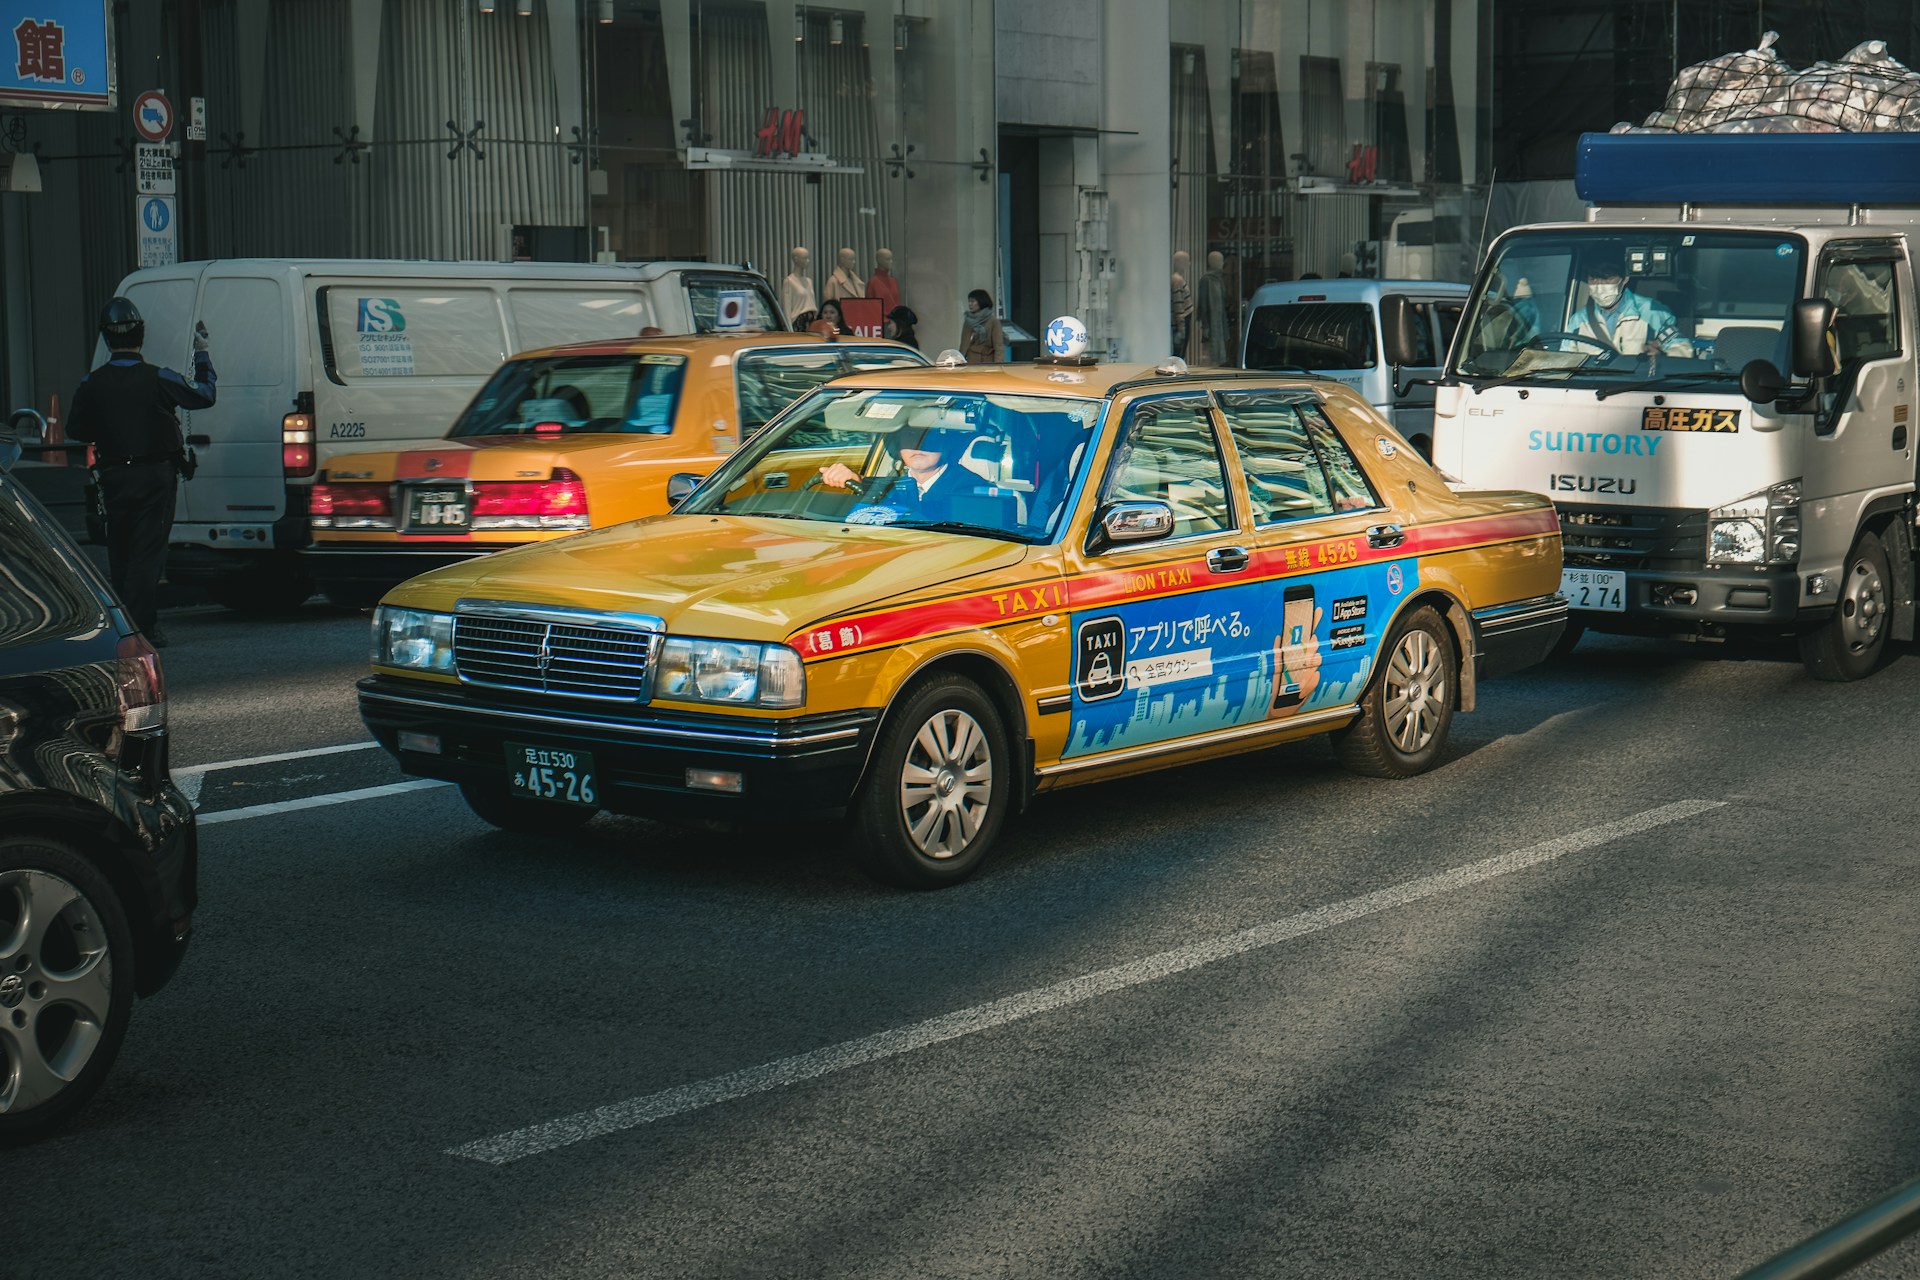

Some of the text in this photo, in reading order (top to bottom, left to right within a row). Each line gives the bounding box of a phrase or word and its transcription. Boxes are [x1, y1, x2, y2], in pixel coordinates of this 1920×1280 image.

[13, 17, 66, 84] 館
[1468, 408, 1505, 417] ELF
[1644, 407, 1738, 433] 高圧ガス
[330, 422, 366, 438] A2225
[1550, 473, 1637, 495] ISUZU
[1285, 540, 1359, 570] 無線 4526
[1124, 567, 1192, 595] LION TAXI
[992, 584, 1062, 616] TAXI
[1340, 605, 1366, 620] App Store
[1086, 631, 1117, 651] TAXI
[1129, 610, 1251, 655] アプリで呼べる。
[1145, 658, 1198, 680] 全国タクシー
[525, 747, 576, 769] 足立530
[513, 766, 595, 804] あ 45-26
